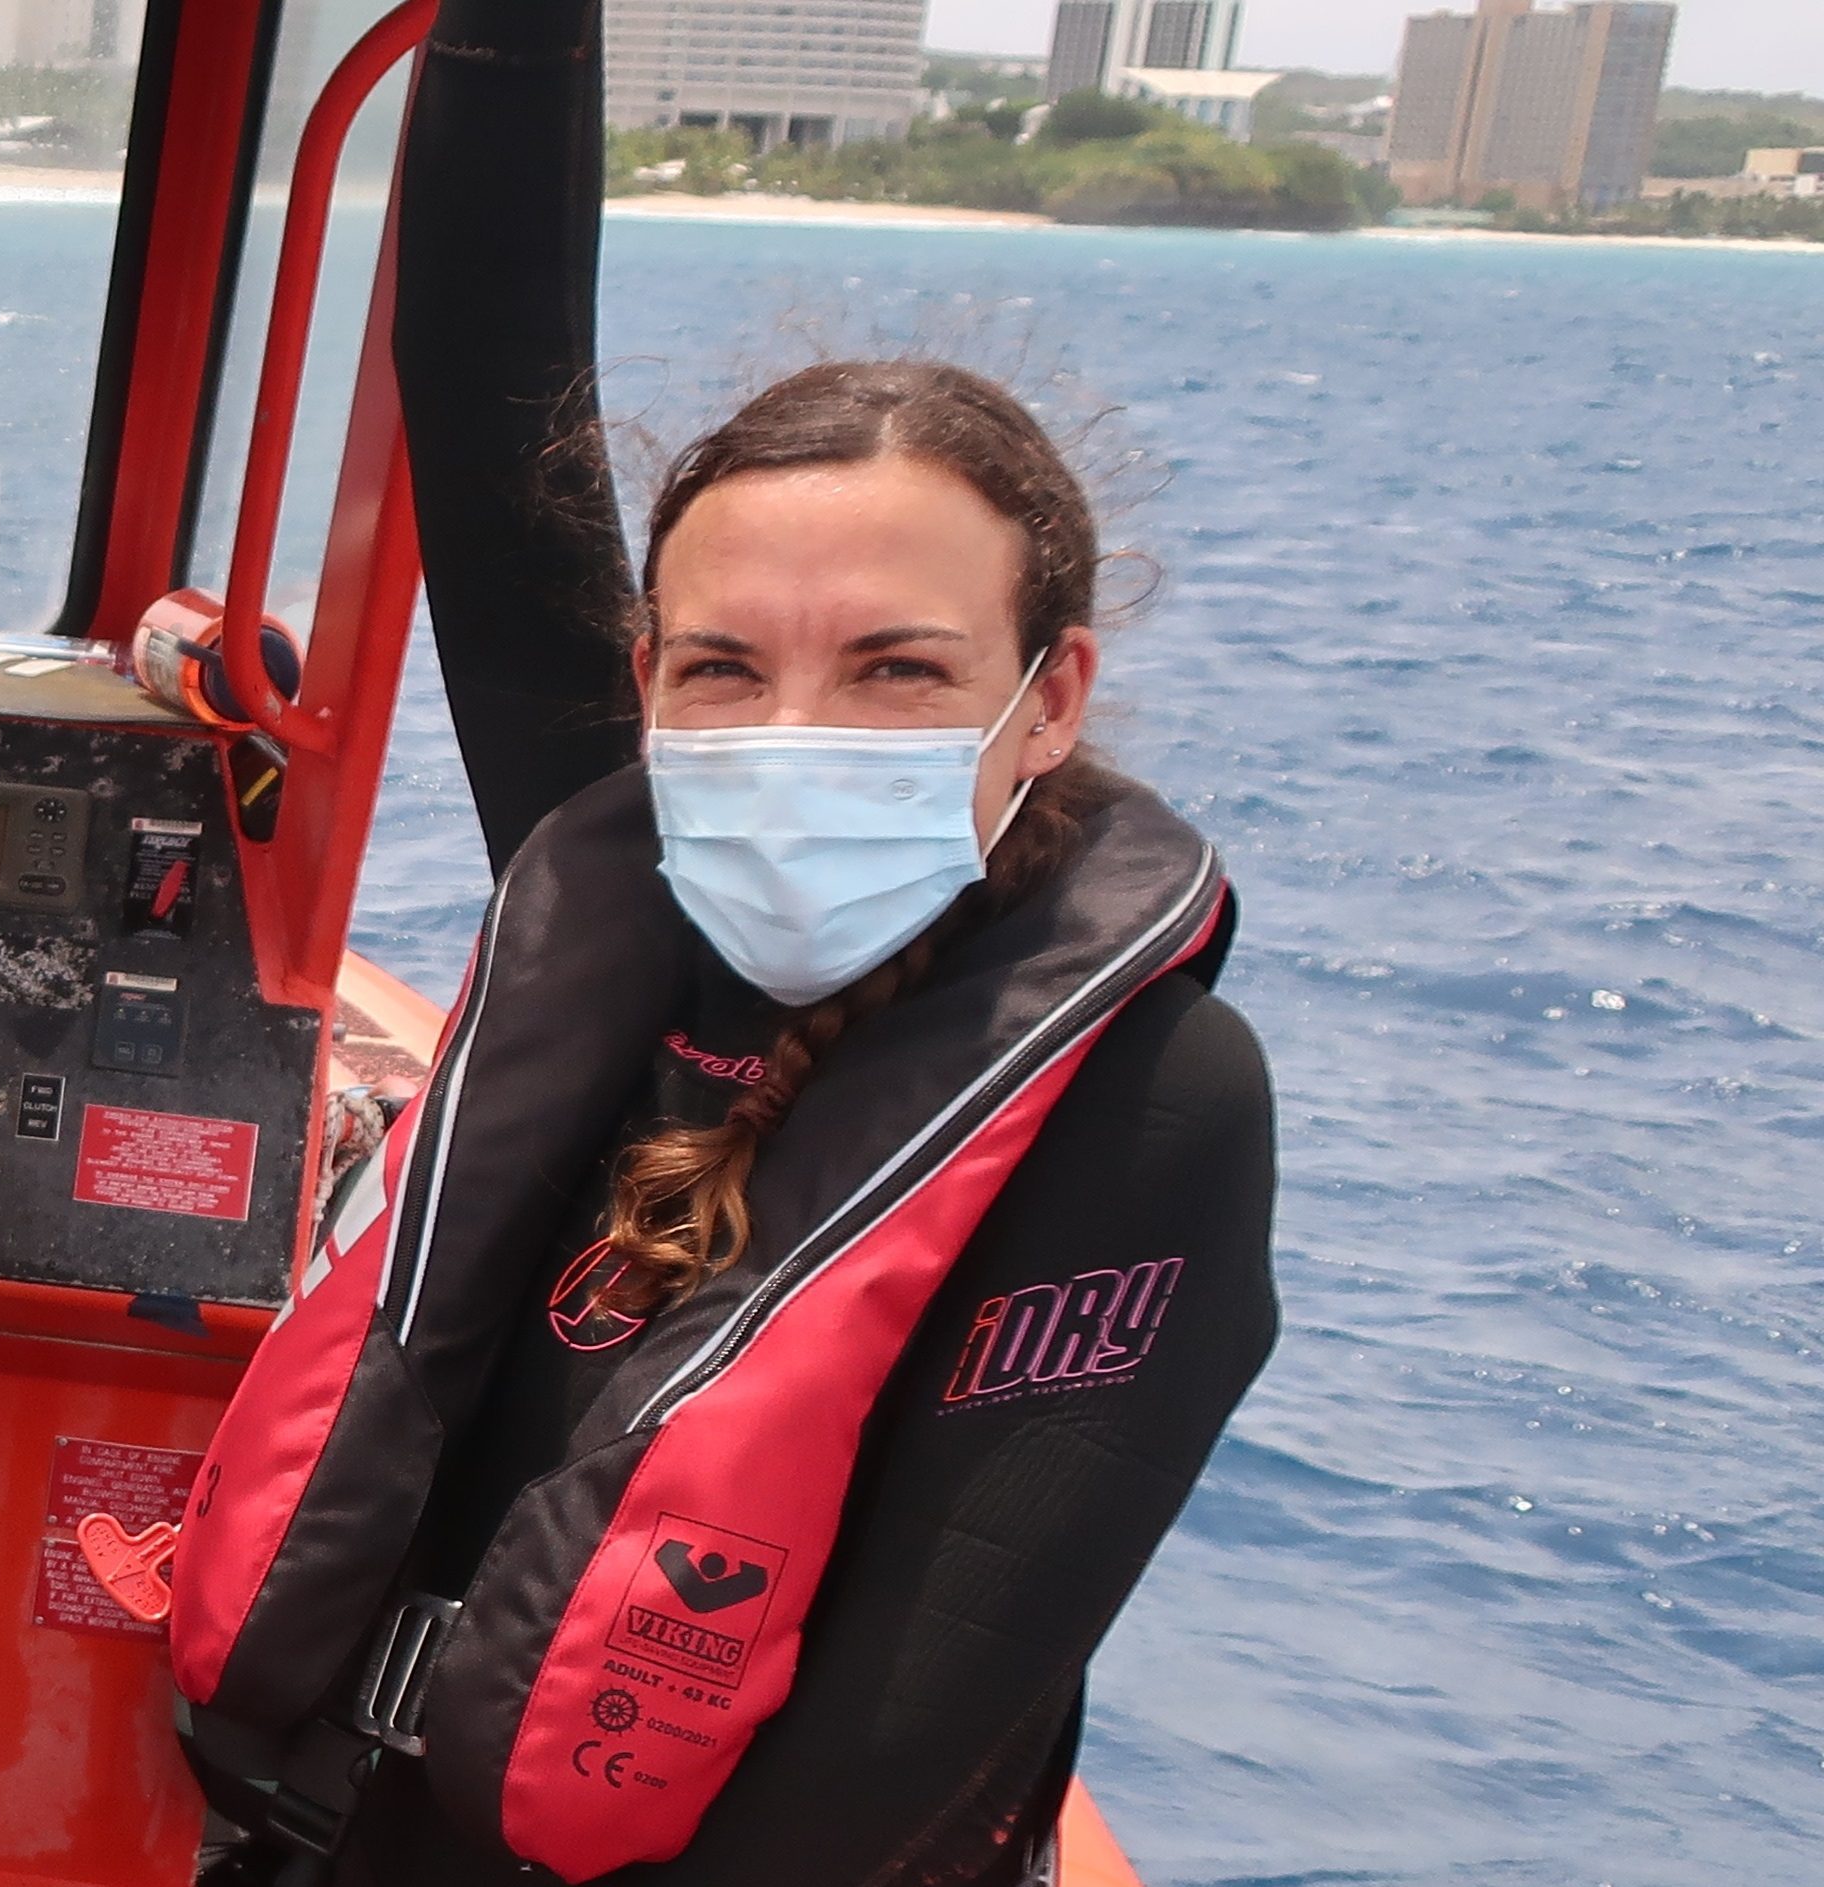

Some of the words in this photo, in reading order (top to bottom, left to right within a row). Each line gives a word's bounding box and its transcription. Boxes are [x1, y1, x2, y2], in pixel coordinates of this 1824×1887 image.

[23, 1102, 57, 1112] CLUTCH
[80, 1456, 148, 1471] COMPARTMENT
[147, 1453, 182, 1465] ENGINE
[197, 1463, 222, 1518] 3
[629, 1609, 743, 1664] VIKING
[603, 1659, 664, 1688] ADULT
[683, 1687, 705, 1702] 43
[708, 1694, 733, 1710] KG
[646, 1716, 718, 1748] 0200/2021
[572, 1740, 634, 1789] CE
